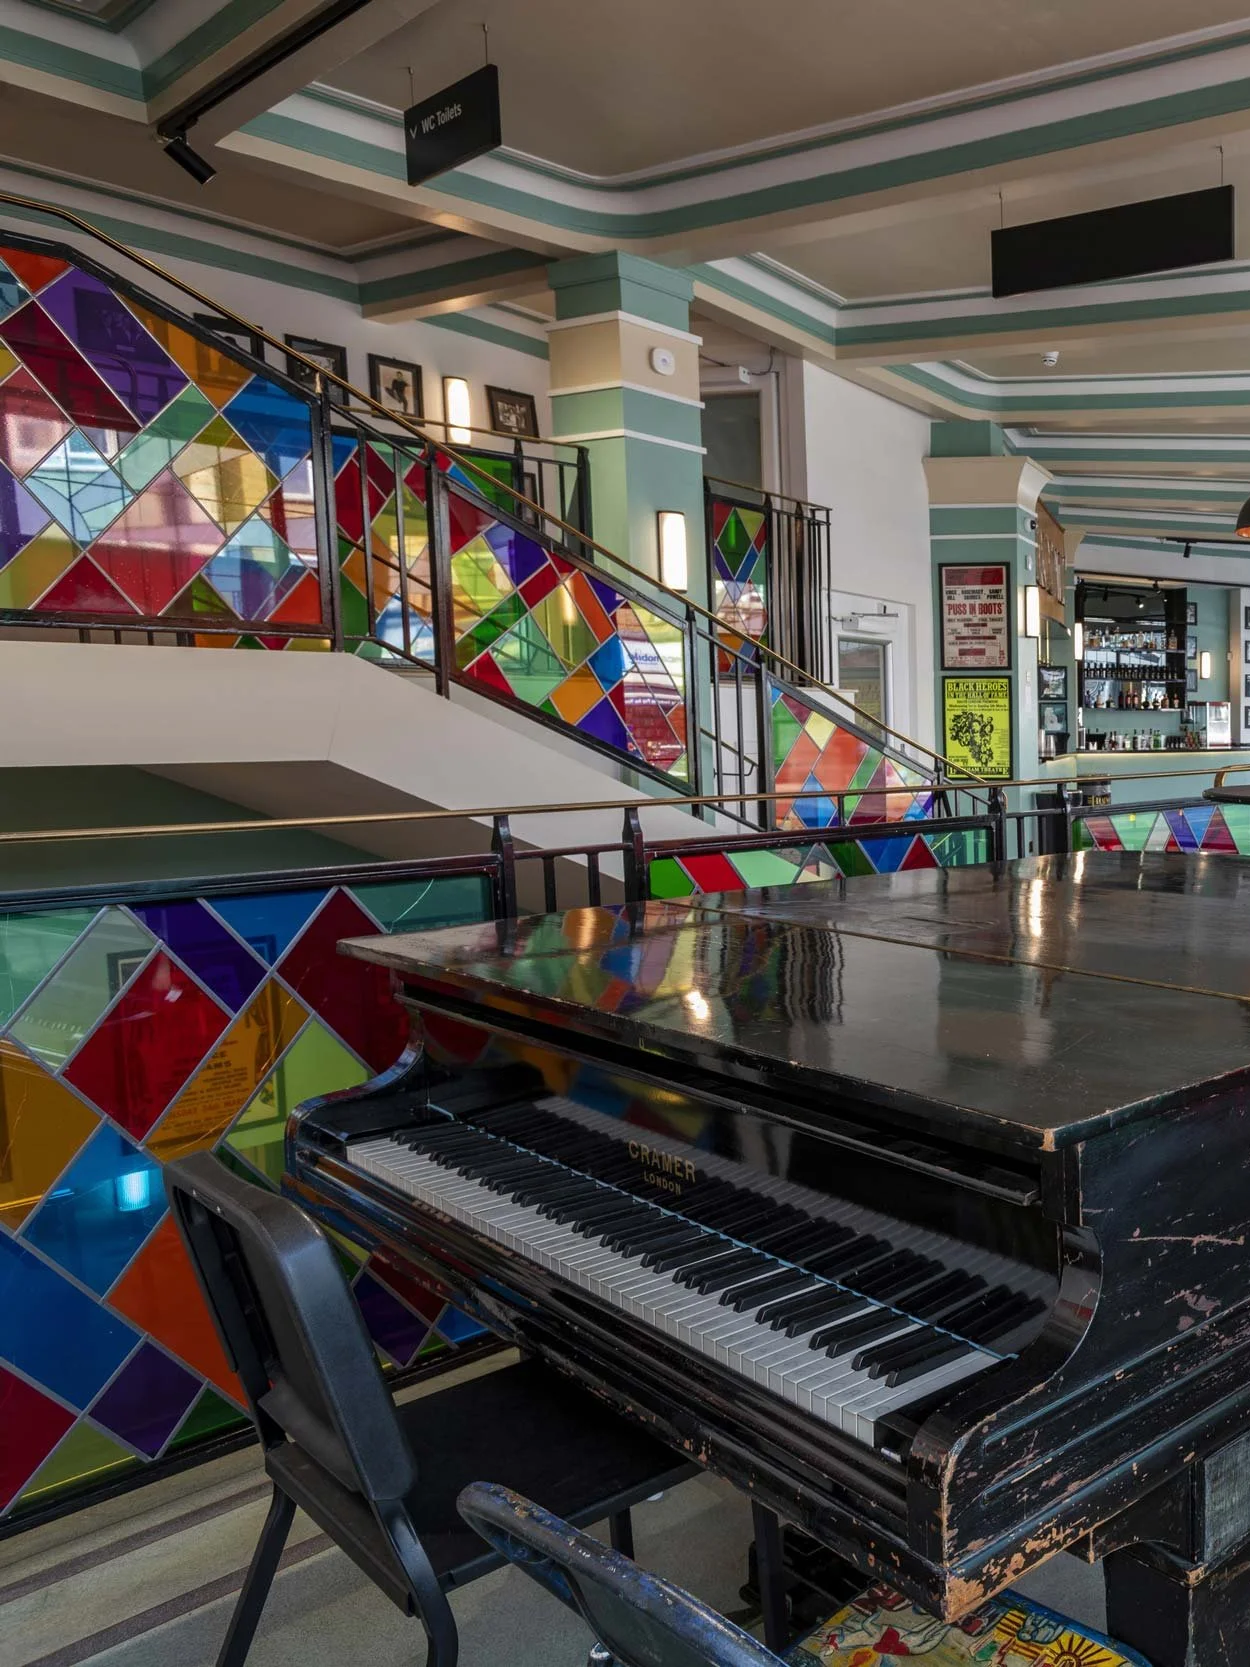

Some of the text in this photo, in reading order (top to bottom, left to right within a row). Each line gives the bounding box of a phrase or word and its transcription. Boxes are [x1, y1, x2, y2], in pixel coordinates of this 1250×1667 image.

[421, 103, 462, 134] WC Toilets
[947, 682, 1007, 691] BLACK HEROES
[628, 1139, 696, 1183] CRAMER
[643, 1170, 682, 1195] LONDON
